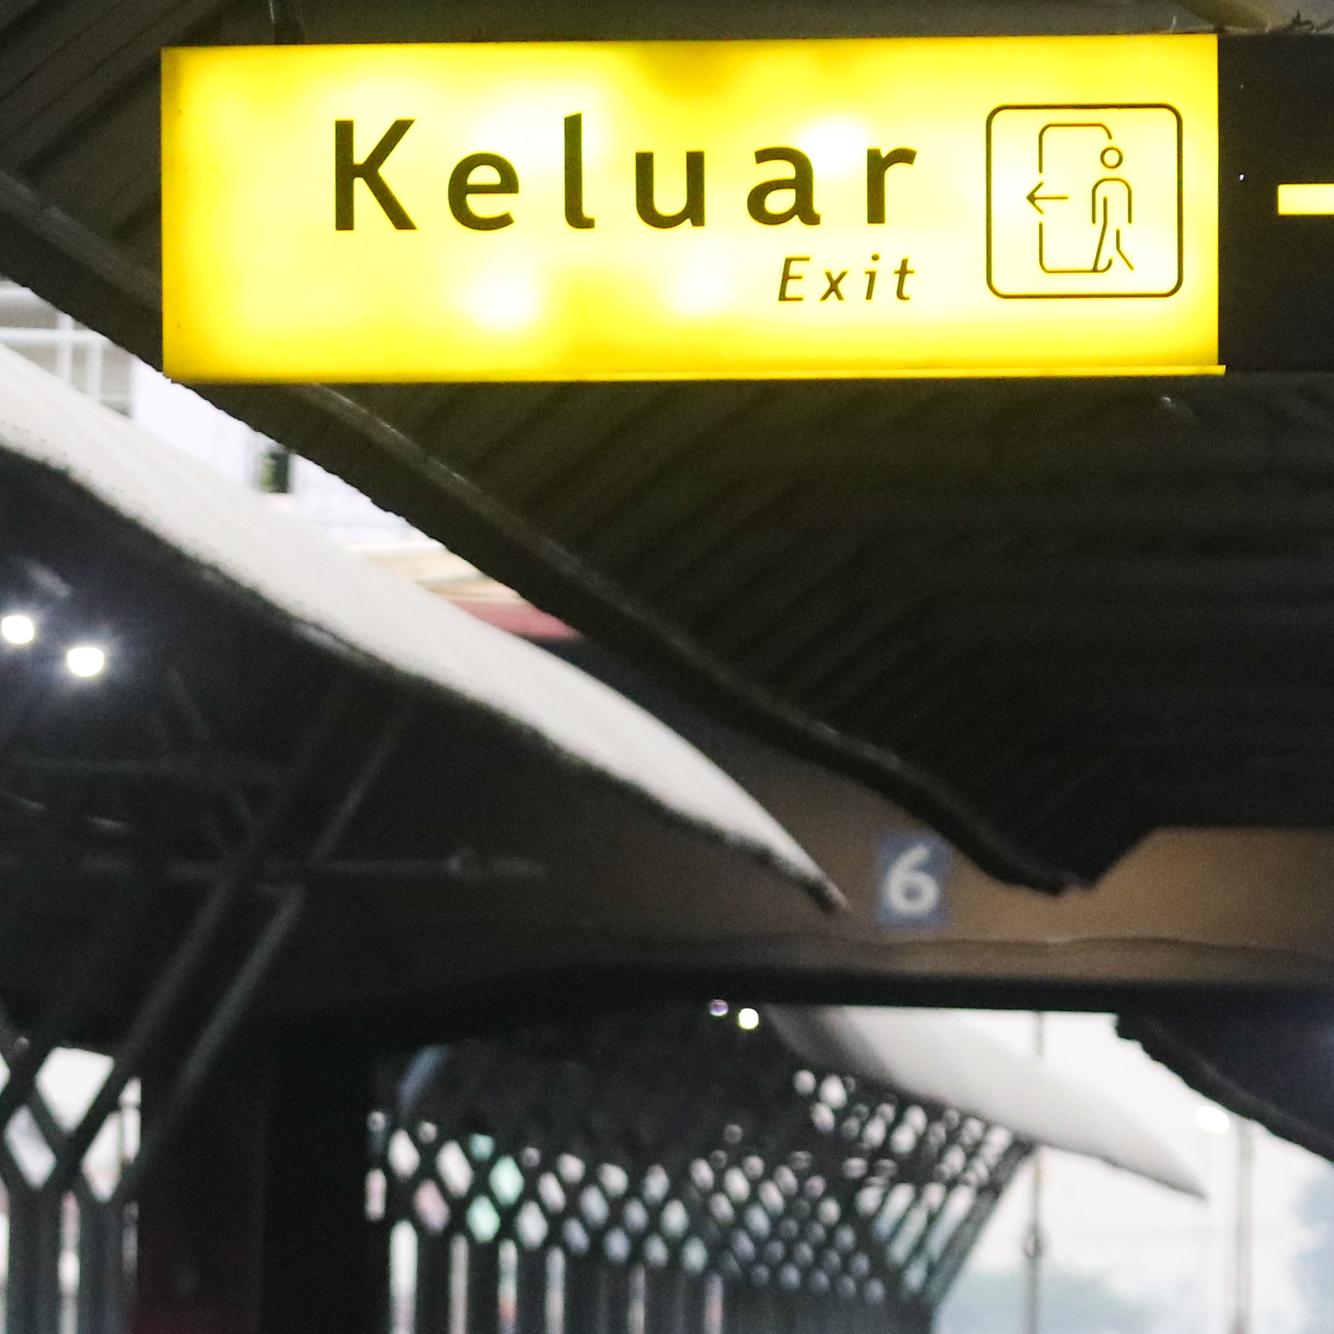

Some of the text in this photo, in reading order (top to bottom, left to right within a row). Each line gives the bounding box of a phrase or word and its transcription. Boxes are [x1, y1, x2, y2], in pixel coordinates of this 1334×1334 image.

[333, 112, 917, 231] Keluar
[778, 253, 915, 302] Exit
[887, 844, 940, 915] 6
